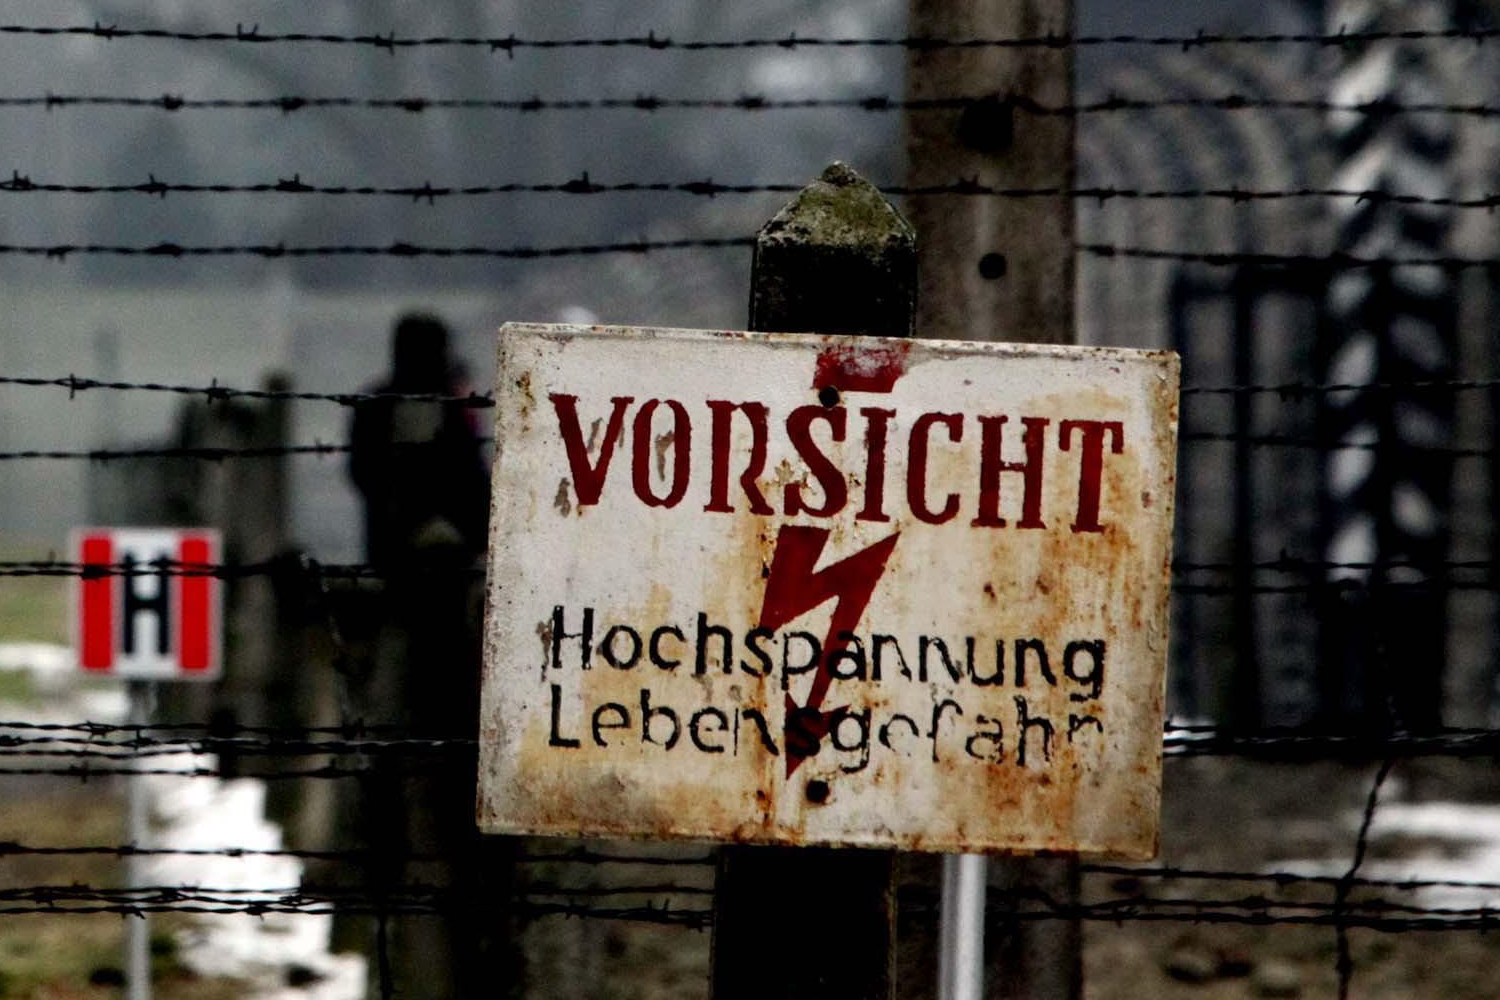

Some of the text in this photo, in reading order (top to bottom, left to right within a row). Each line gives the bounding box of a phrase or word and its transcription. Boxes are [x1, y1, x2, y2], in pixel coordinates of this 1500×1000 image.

[549, 393, 1124, 533] VORSICHT
[123, 552, 170, 656] H
[552, 605, 1106, 700] Hochspannung
